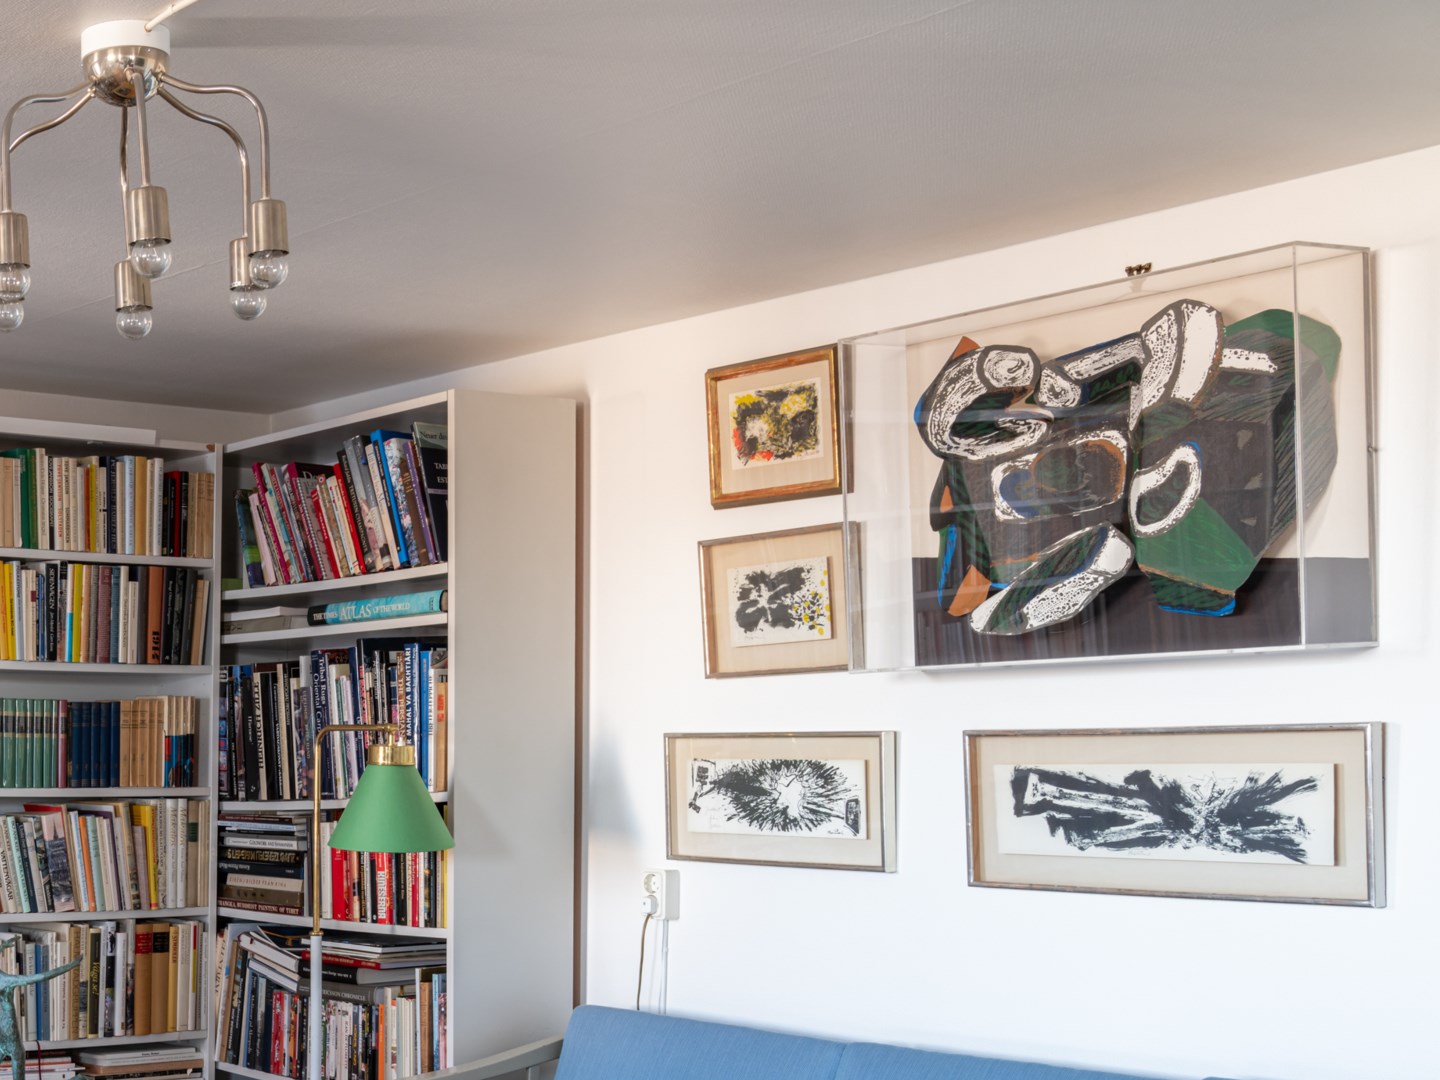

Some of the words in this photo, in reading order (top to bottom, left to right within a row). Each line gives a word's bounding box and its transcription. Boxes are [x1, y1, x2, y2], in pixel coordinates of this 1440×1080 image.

[339, 604, 372, 620] ATLAS
[152, 630, 160, 660] 1914
[319, 657, 327, 683] Tribal
[0, 850, 13, 900] VATTENVÄGAR
[378, 871, 386, 918] KINESERNA
[92, 962, 100, 977] Våga
